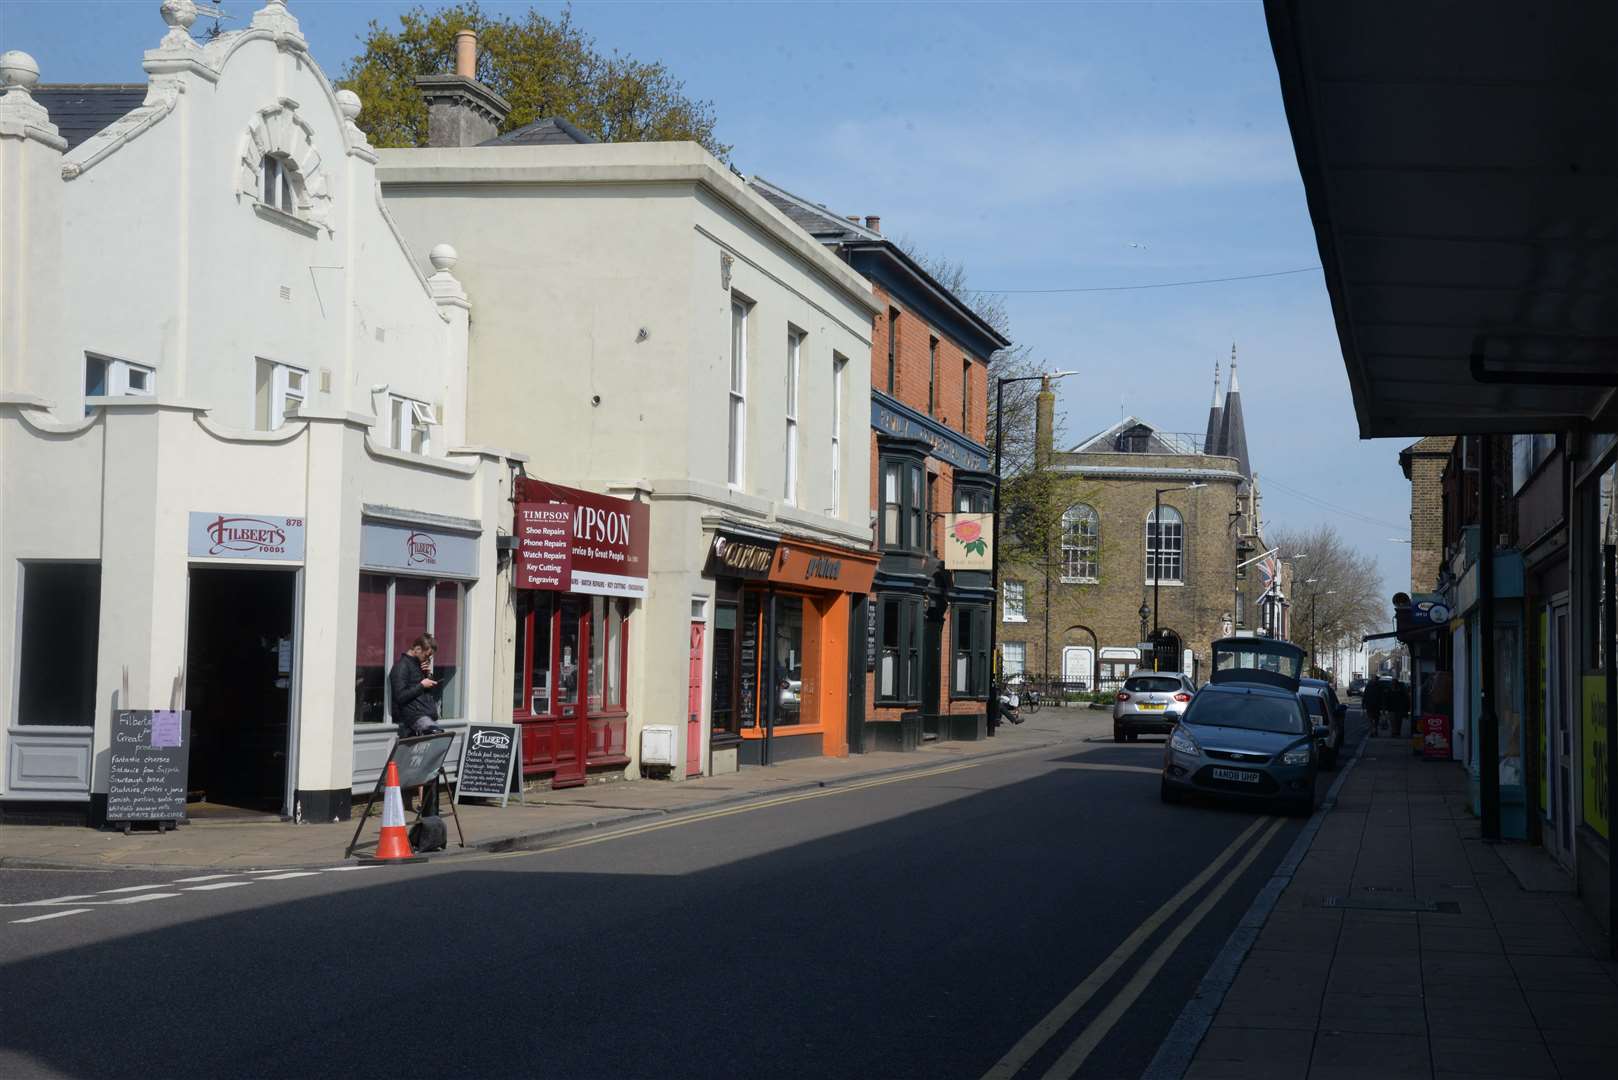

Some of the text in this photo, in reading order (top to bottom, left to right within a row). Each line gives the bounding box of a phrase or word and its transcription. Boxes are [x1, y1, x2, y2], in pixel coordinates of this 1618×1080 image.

[523, 511, 570, 521] TIMPSON
[286, 518, 303, 527] 87B
[207, 516, 287, 548] FILBERTS
[526, 527, 566, 537] Shoe Repairs
[259, 544, 286, 554] FOODS
[524, 539, 567, 549] Phone Repairs
[523, 551, 567, 561] Watch Repairs
[595, 548, 609, 558] Great
[609, 550, 625, 562] People
[527, 563, 562, 574] Key Cutting
[528, 576, 560, 586] Engraving
